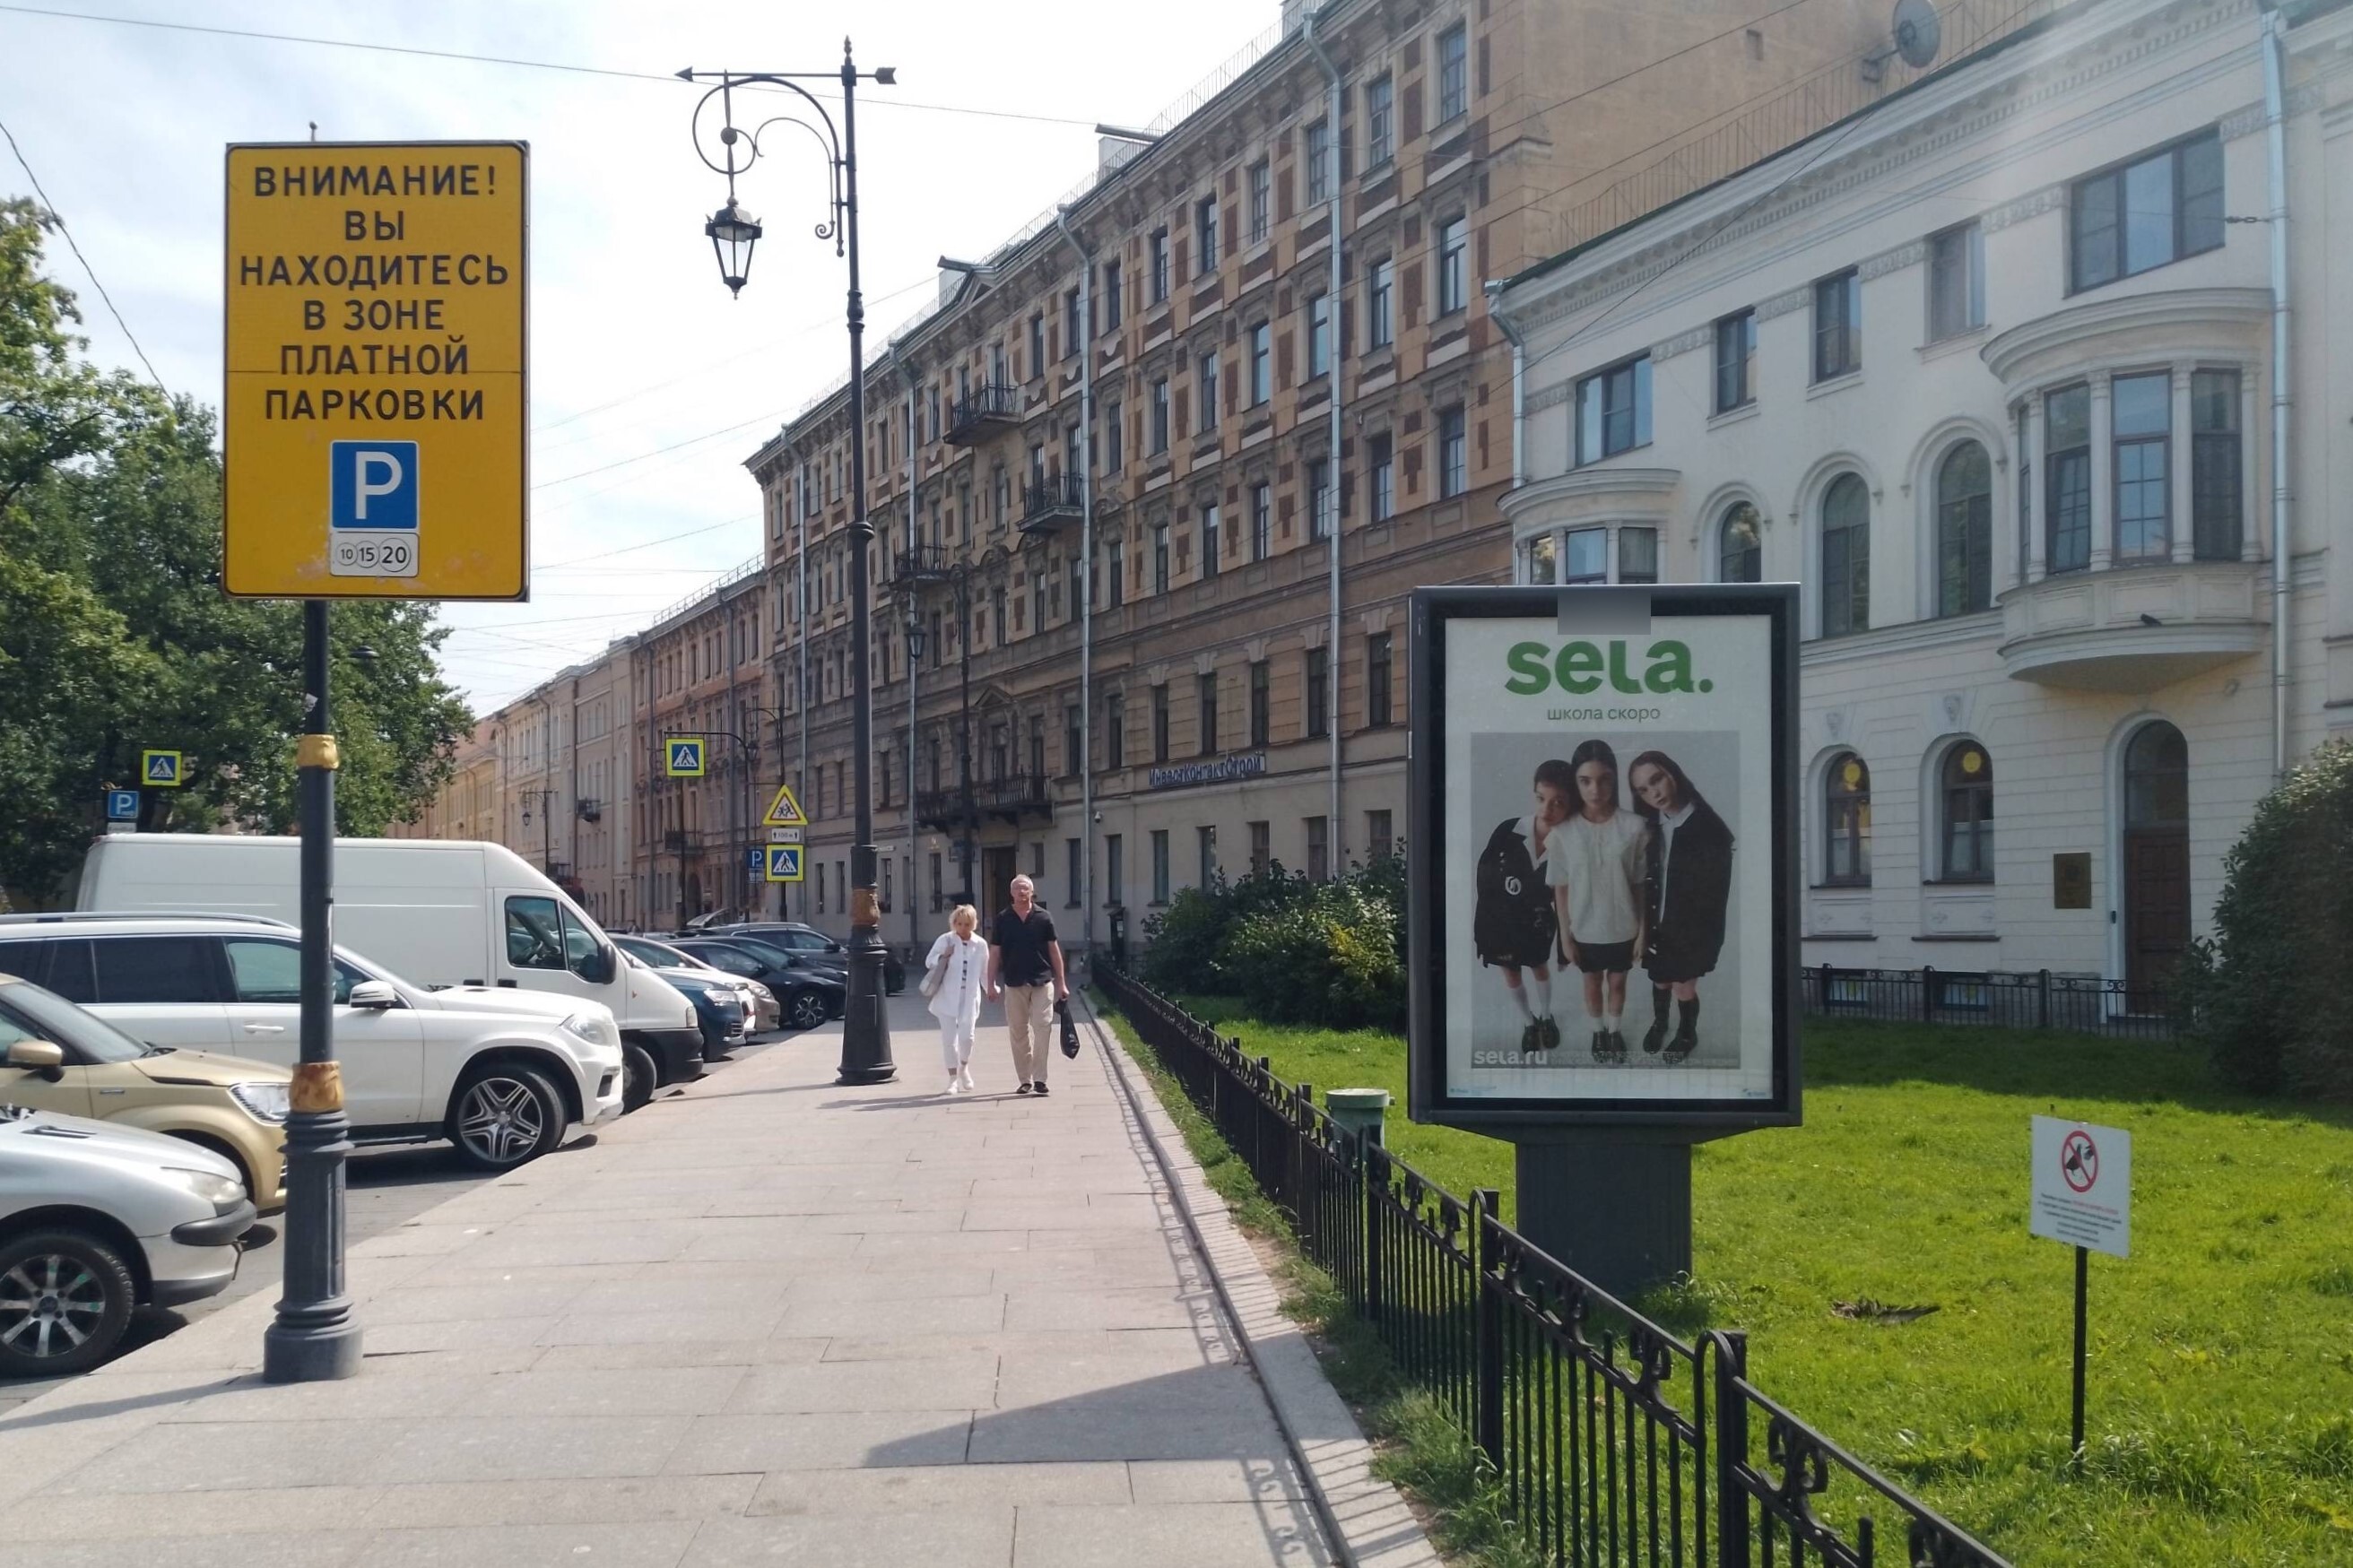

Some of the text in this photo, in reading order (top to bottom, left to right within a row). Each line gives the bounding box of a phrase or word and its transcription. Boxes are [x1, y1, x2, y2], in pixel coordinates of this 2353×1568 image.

[254, 164, 497, 197] ВНИМАНИЕ!
[344, 210, 404, 241] ВЫ
[239, 254, 508, 290] НАХОДИТЕСЬ
[303, 299, 445, 331] В ЗОНЕ
[280, 334, 469, 376] ПЛАТНОЙ
[265, 388, 484, 420] ПАРКОВКИ
[340, 545, 407, 564] 10 15 20
[1504, 639, 1715, 696] sela.
[1547, 707, 1662, 723] школа скоро
[1473, 1049, 1549, 1066] sela.ru
